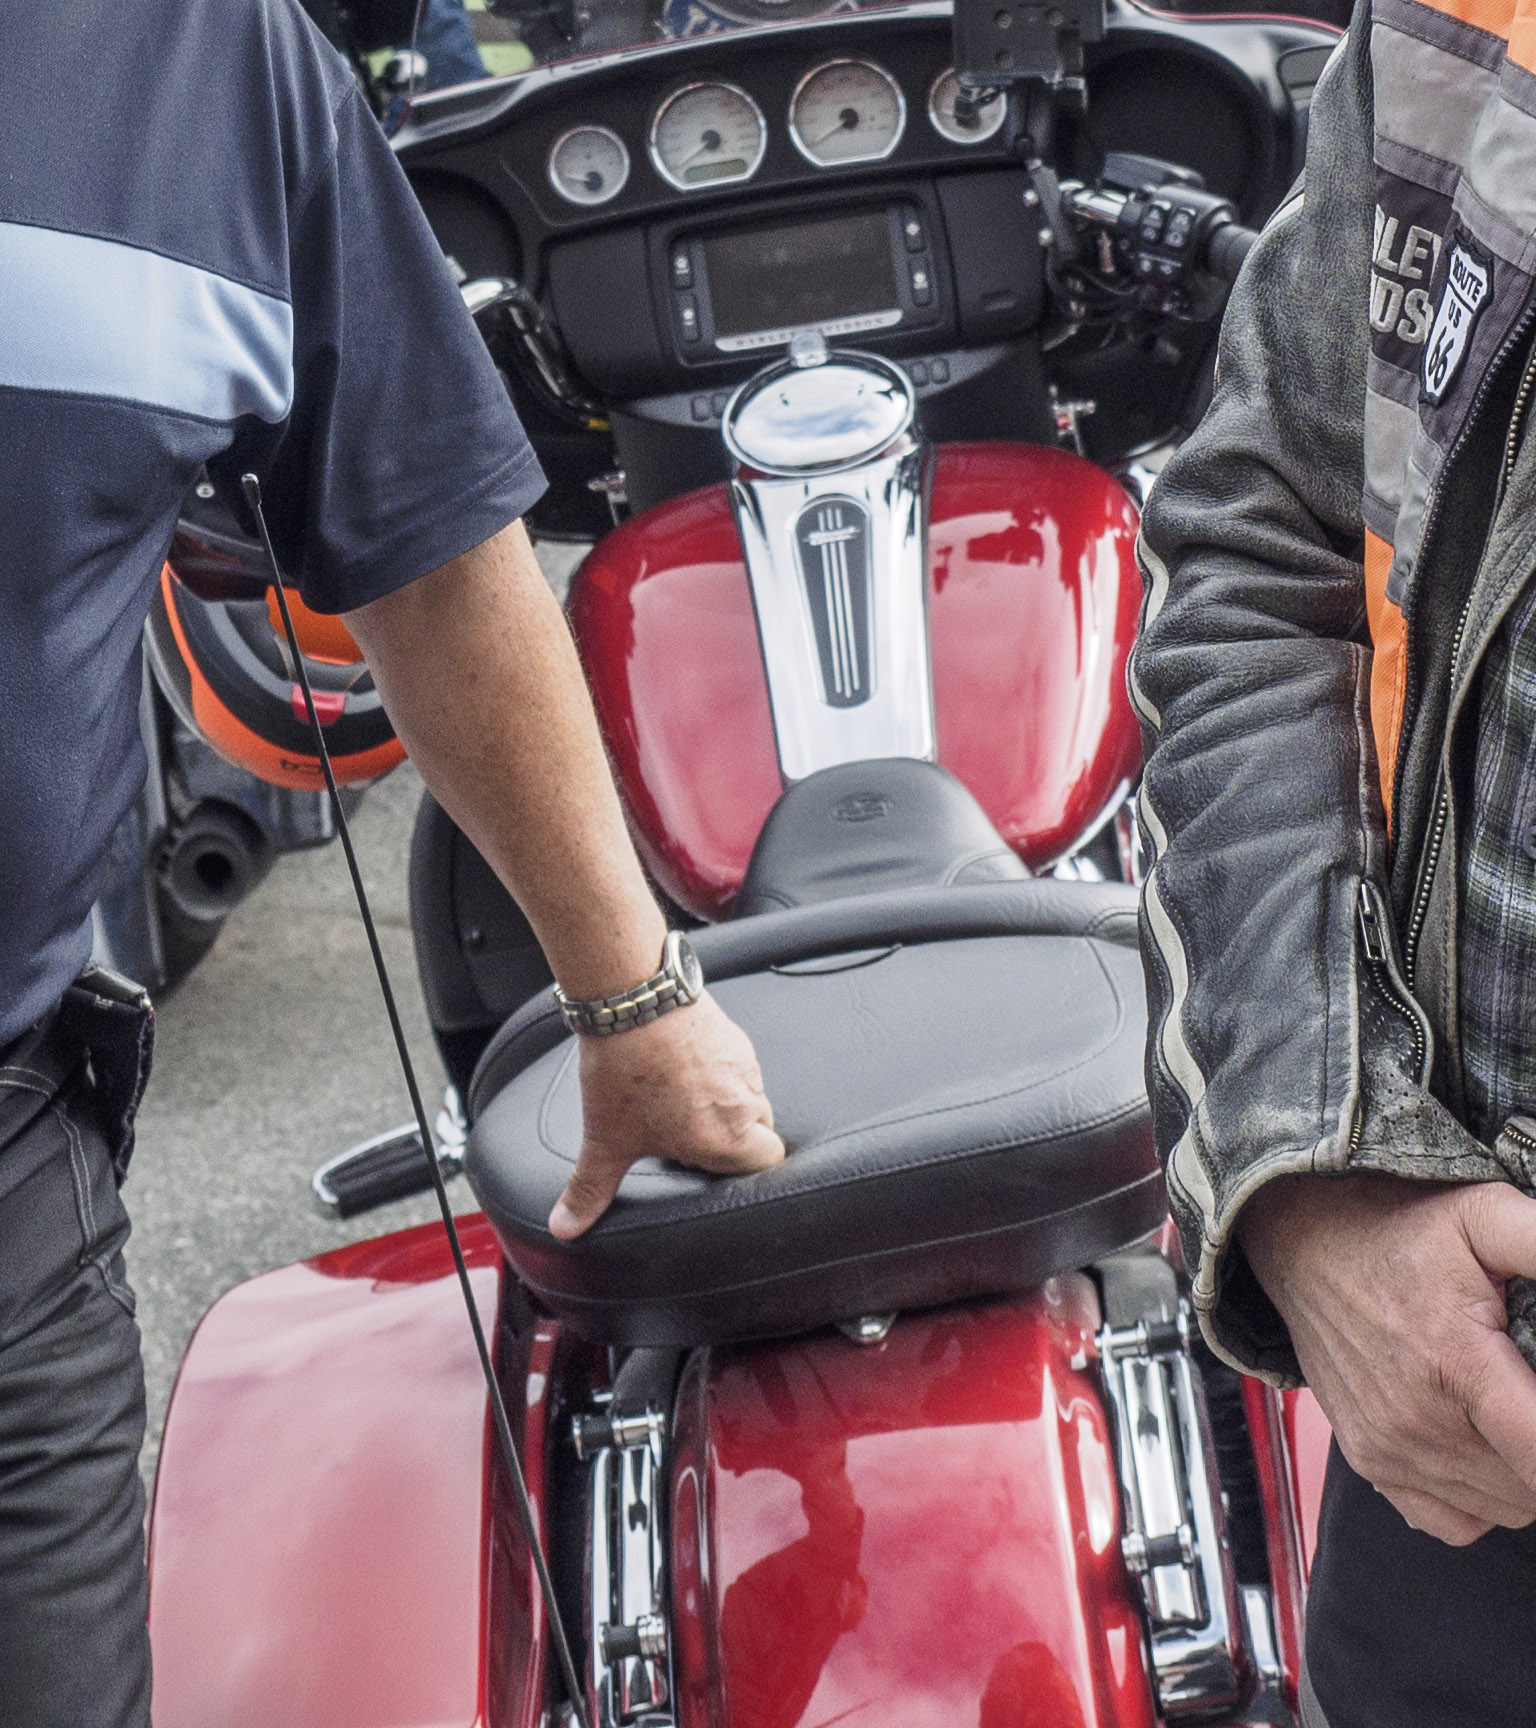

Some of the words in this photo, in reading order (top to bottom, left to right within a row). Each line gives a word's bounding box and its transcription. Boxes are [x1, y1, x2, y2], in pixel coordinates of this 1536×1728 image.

[1453, 253, 1484, 303] ROUTE
[1448, 299, 1462, 329] US
[1428, 326, 1454, 390] 66
